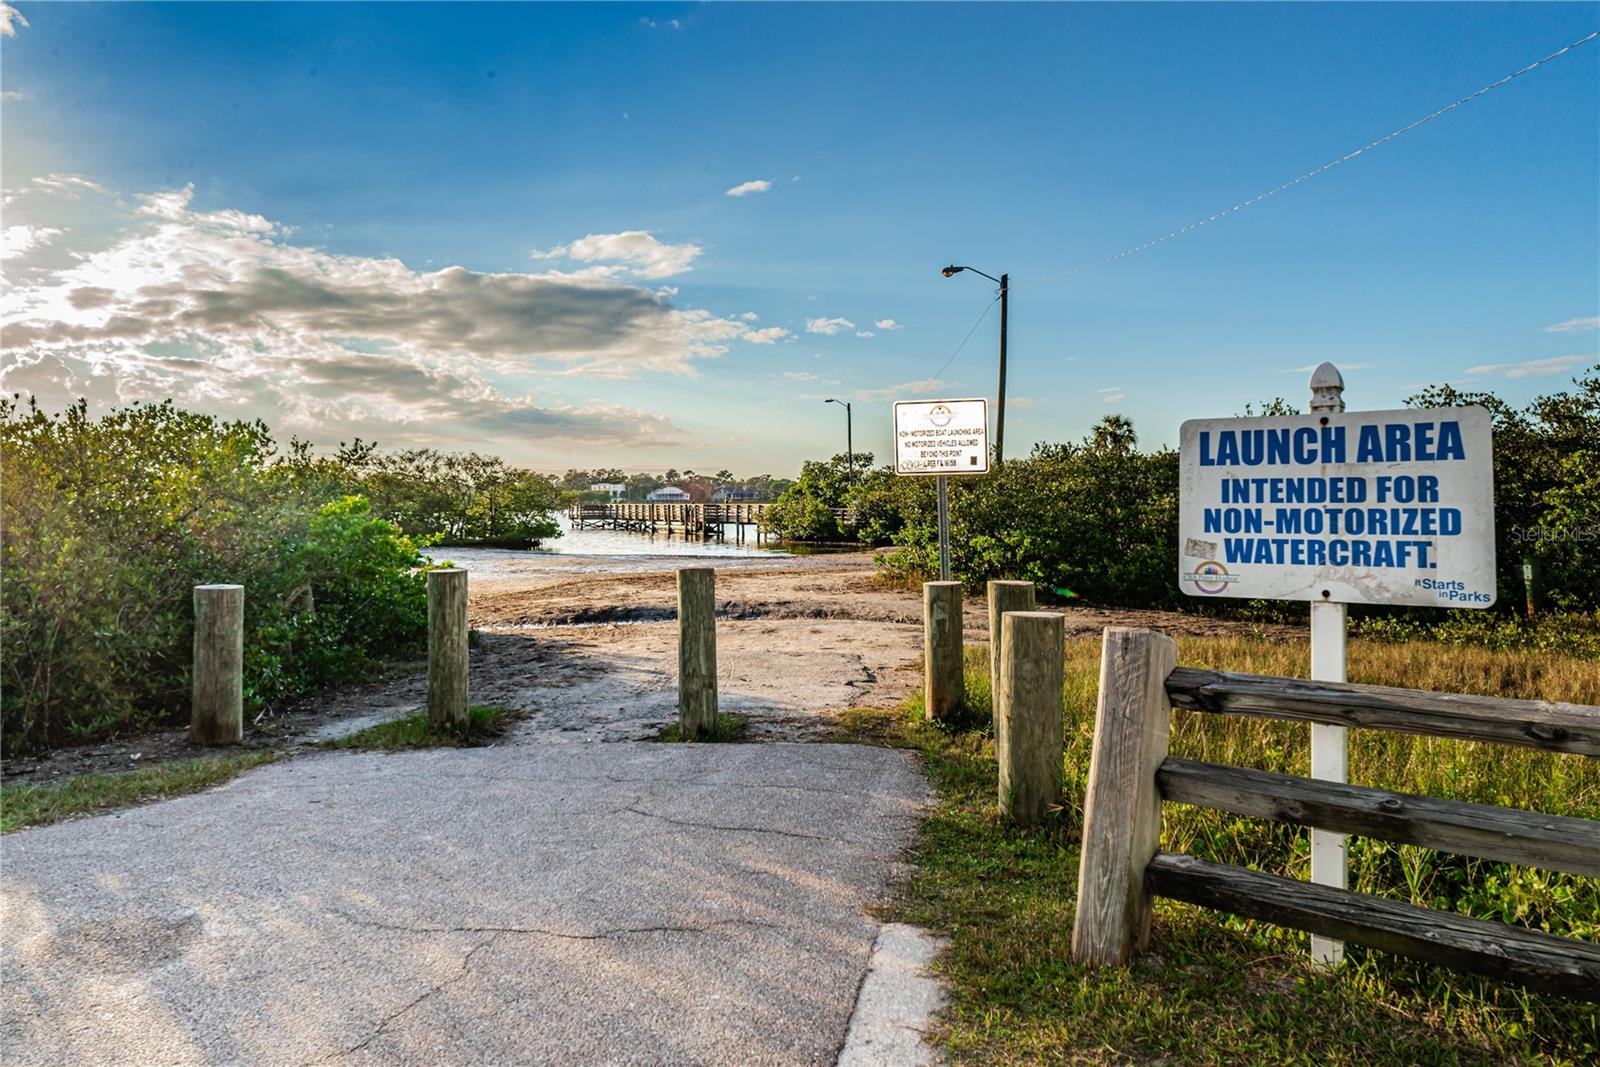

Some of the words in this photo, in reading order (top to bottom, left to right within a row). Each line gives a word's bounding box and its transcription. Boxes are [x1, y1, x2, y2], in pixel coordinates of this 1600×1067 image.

[1199, 426, 1346, 466] LAUNCH
[1357, 421, 1465, 463] AREA
[1221, 476, 1367, 503] INTENDED
[1377, 475, 1439, 503] FOR
[1204, 507, 1462, 536] NON-MOTORIZED
[1224, 538, 1437, 568] WATERCRAFT.
[1422, 578, 1464, 590] Starts
[1449, 591, 1491, 602] Parks
